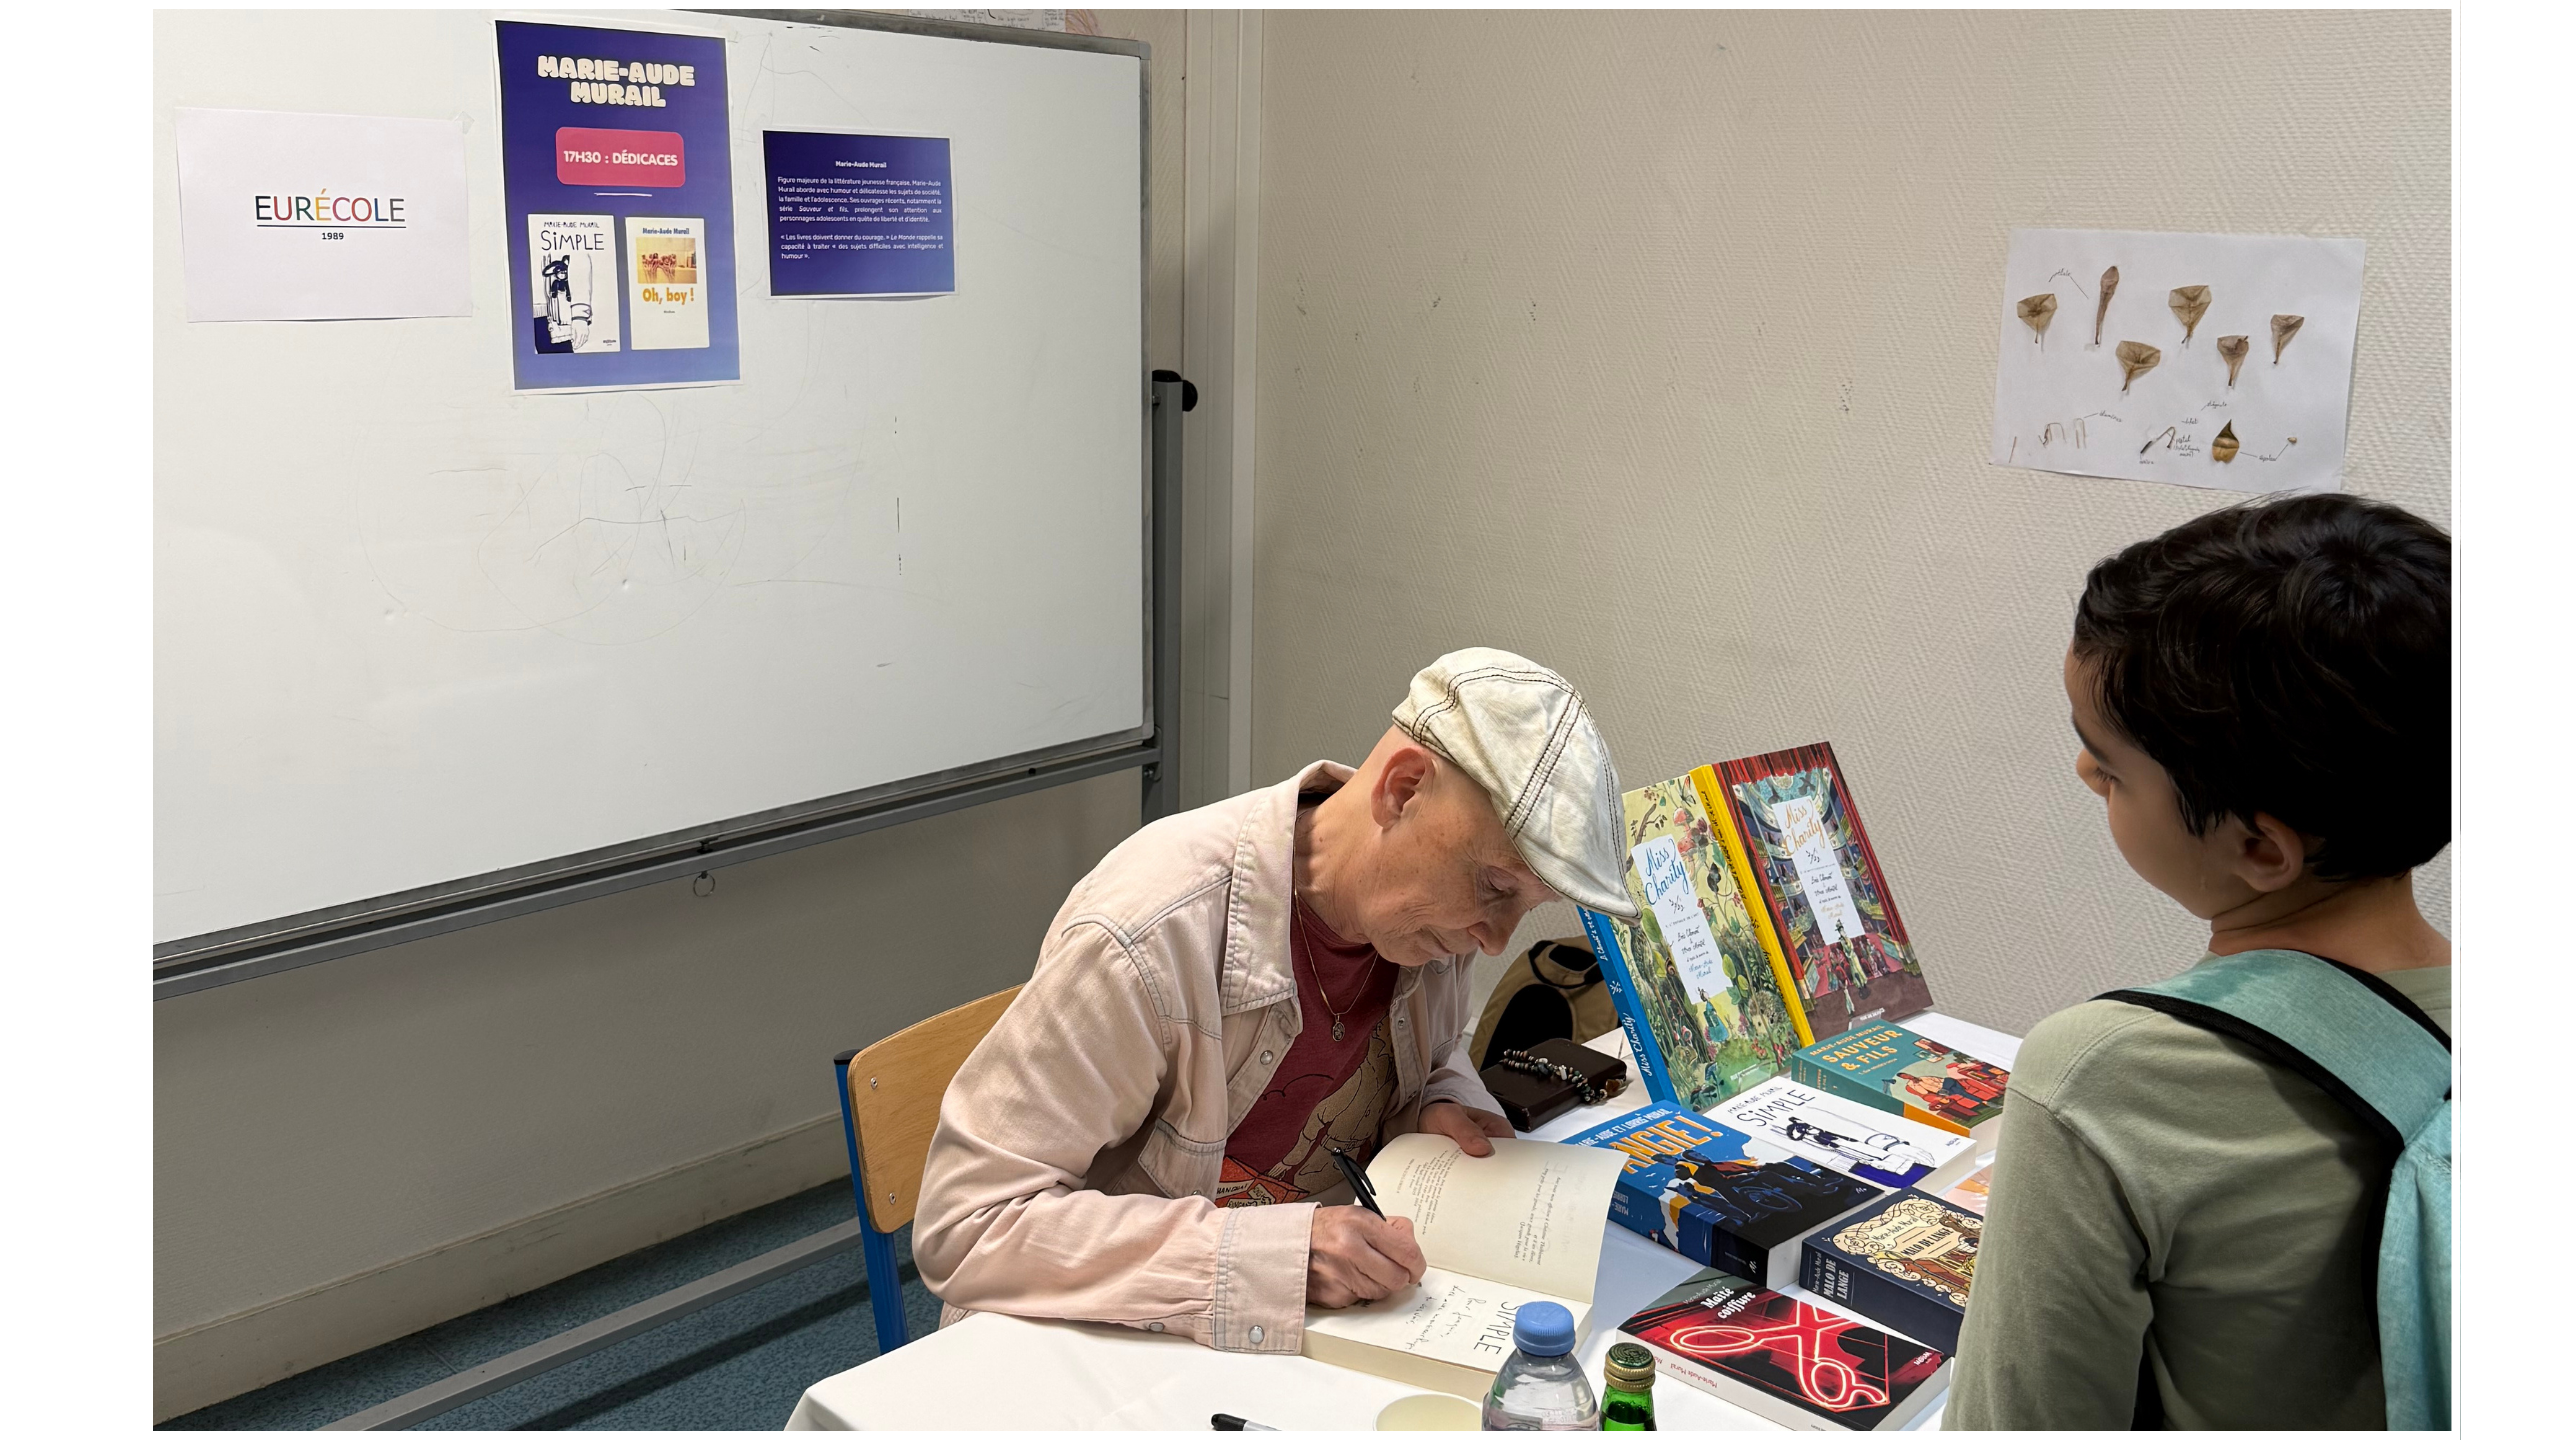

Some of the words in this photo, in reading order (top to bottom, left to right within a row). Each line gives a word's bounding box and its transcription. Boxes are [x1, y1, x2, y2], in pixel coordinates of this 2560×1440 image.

[537, 55, 695, 86] MARIE-AUDE
[570, 82, 666, 107] MURAIL
[564, 151, 600, 163] 17H30
[605, 155, 609, 164] :
[612, 149, 678, 166] DÉDICACES
[255, 188, 405, 222] EURÉCOLE
[642, 288, 663, 304] Oh,
[666, 287, 687, 305] boy
[690, 288, 694, 301] !
[1785, 800, 1814, 829] Miss
[1783, 820, 1825, 856] Charity
[1646, 839, 1676, 877] Miss
[1644, 861, 1689, 905] Charity
[1623, 1013, 1644, 1053] Charity
[1809, 1035, 1857, 1056] MARIE-AUDE
[1856, 1025, 1885, 1037] MURAIL
[1822, 1030, 1903, 1063] SAUVEUR
[1640, 1053, 1652, 1077] Miss
[1841, 1062, 1860, 1071] &
[1856, 1046, 1898, 1064] FILS
[1872, 1223, 1903, 1242] Marie-Aude
[1900, 1242, 1925, 1258] MALO
[1923, 1237, 1933, 1248] DE
[1932, 1227, 1954, 1243] LANGE
[1826, 1258, 1837, 1273] DE
[1700, 1286, 1734, 1309] Maïté
[1823, 1274, 1836, 1298] MALO
[1836, 1271, 1850, 1300] LANGE
[1717, 1291, 1756, 1319] coiffure
